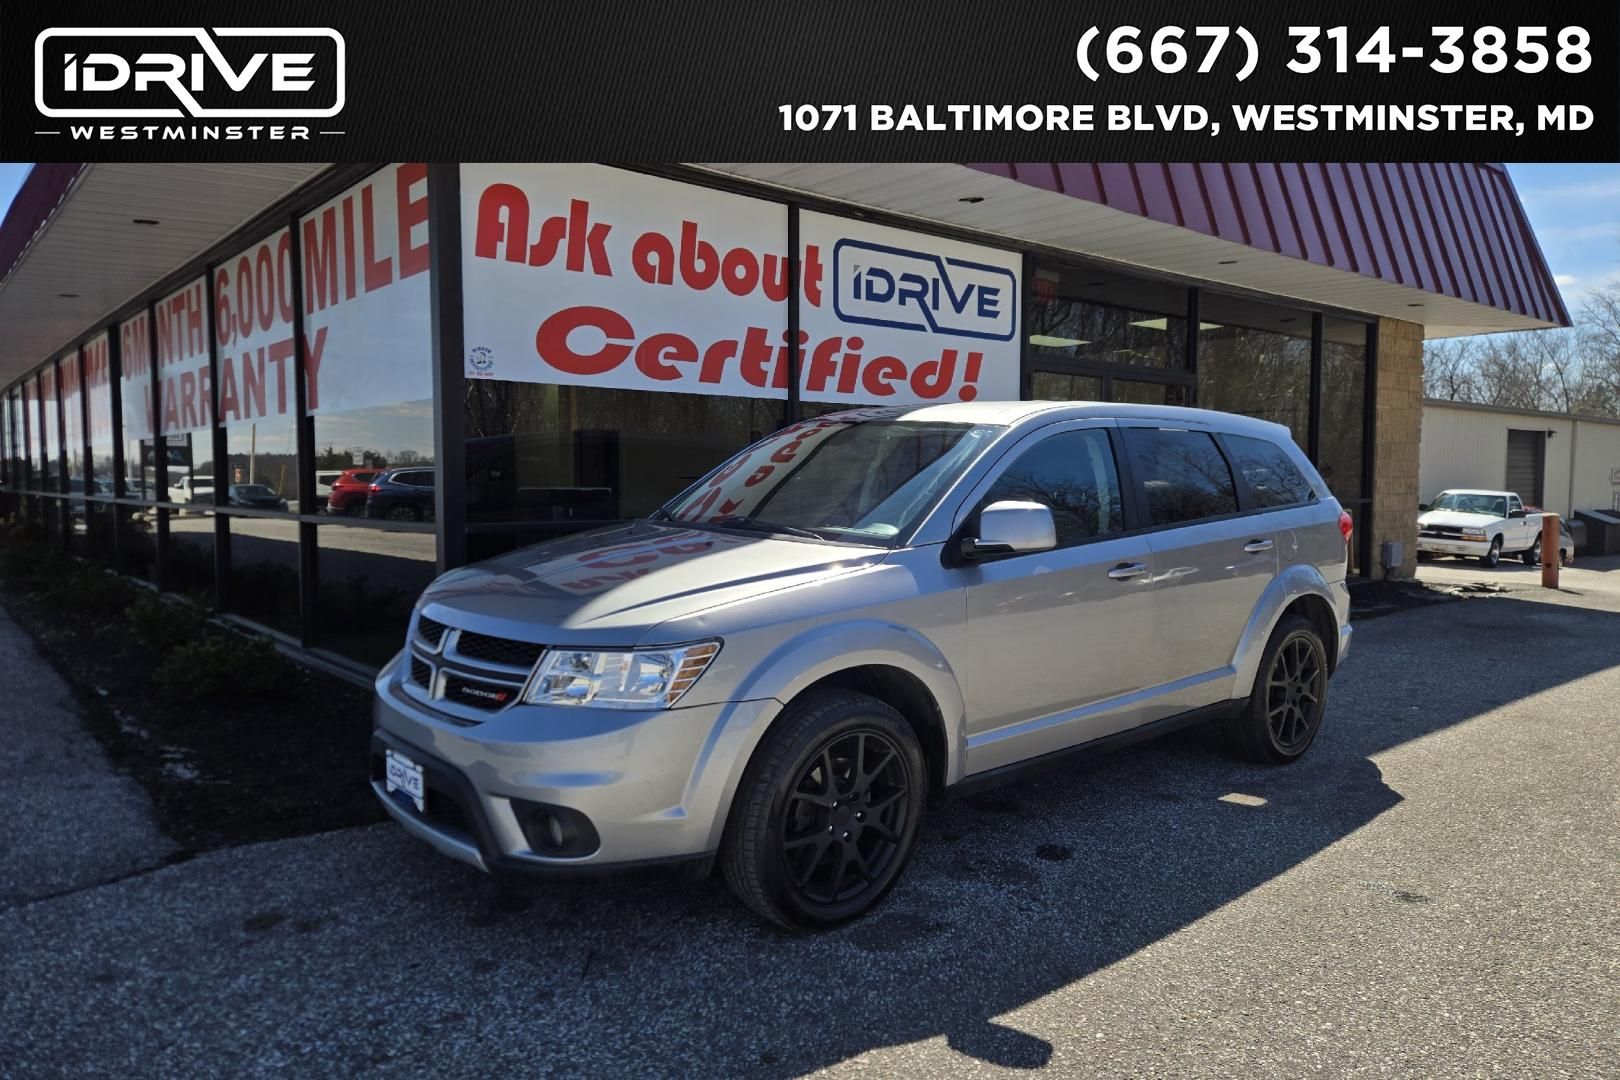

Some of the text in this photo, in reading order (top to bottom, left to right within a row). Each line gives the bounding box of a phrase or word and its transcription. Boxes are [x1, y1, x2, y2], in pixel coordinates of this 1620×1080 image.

[475, 183, 613, 278] Ask
[632, 221, 824, 307] about
[132, 284, 205, 377] MNTH
[535, 306, 983, 402] Certified!
